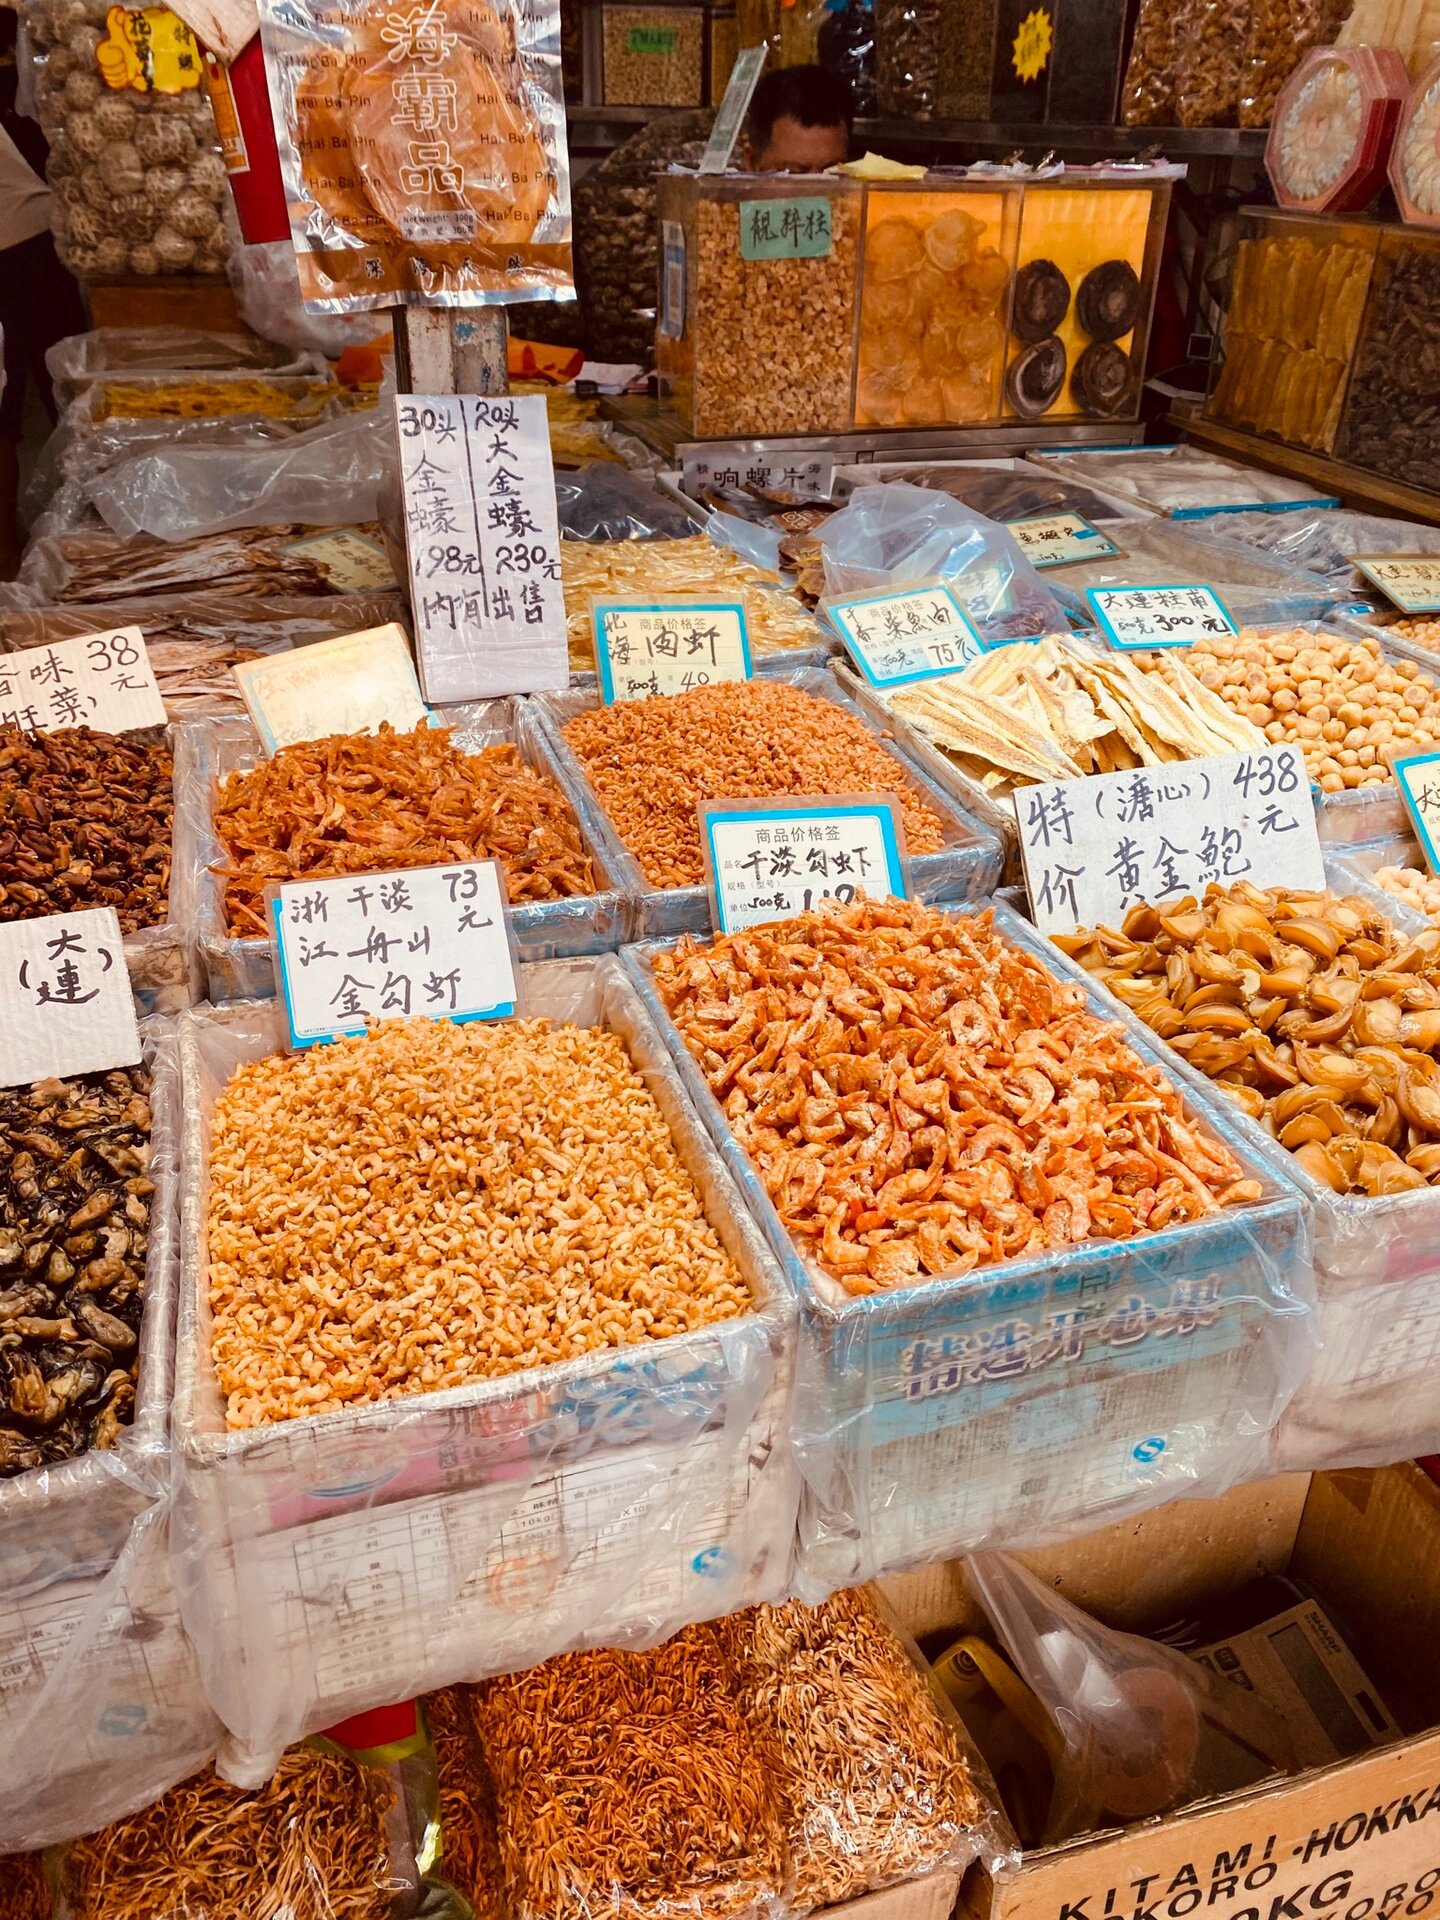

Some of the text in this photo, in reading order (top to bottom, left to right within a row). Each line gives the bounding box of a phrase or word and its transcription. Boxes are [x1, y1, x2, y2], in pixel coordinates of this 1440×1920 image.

[324, 97, 342, 108] Ba
[349, 95, 371, 107] Pin
[380, 5, 465, 196] 海霸品
[477, 94, 498, 105] Hai
[332, 137, 348, 148] Ba
[353, 136, 376, 147] Pin
[508, 132, 526, 144] Ba
[309, 178, 332, 189] Hai
[338, 176, 355, 188] Ba
[511, 172, 528, 184] Ba
[343, 215, 360, 226] Ba
[486, 211, 509, 221] Hai
[513, 210, 530, 221] Ba
[399, 406, 457, 444] 30头
[474, 400, 520, 434] 20头
[713, 467, 806, 489] 响螺片
[415, 545, 483, 579] 198元
[495, 543, 563, 580] 230元
[639, 617, 707, 632] 商品价格签
[86, 635, 139, 672] 38
[110, 672, 149, 692] 元
[1232, 750, 1300, 799] 438
[1257, 803, 1300, 836] 元
[755, 825, 841, 845] 商品价格签
[1027, 786, 1086, 925] 特价
[441, 869, 479, 902] 73
[747, 891, 791, 913] 500克
[457, 904, 494, 933] 元
[328, 967, 461, 1019] 金勾虾
[1057, 1834, 1277, 1920] KITAMI
[1104, 1861, 1278, 1920] KORO
